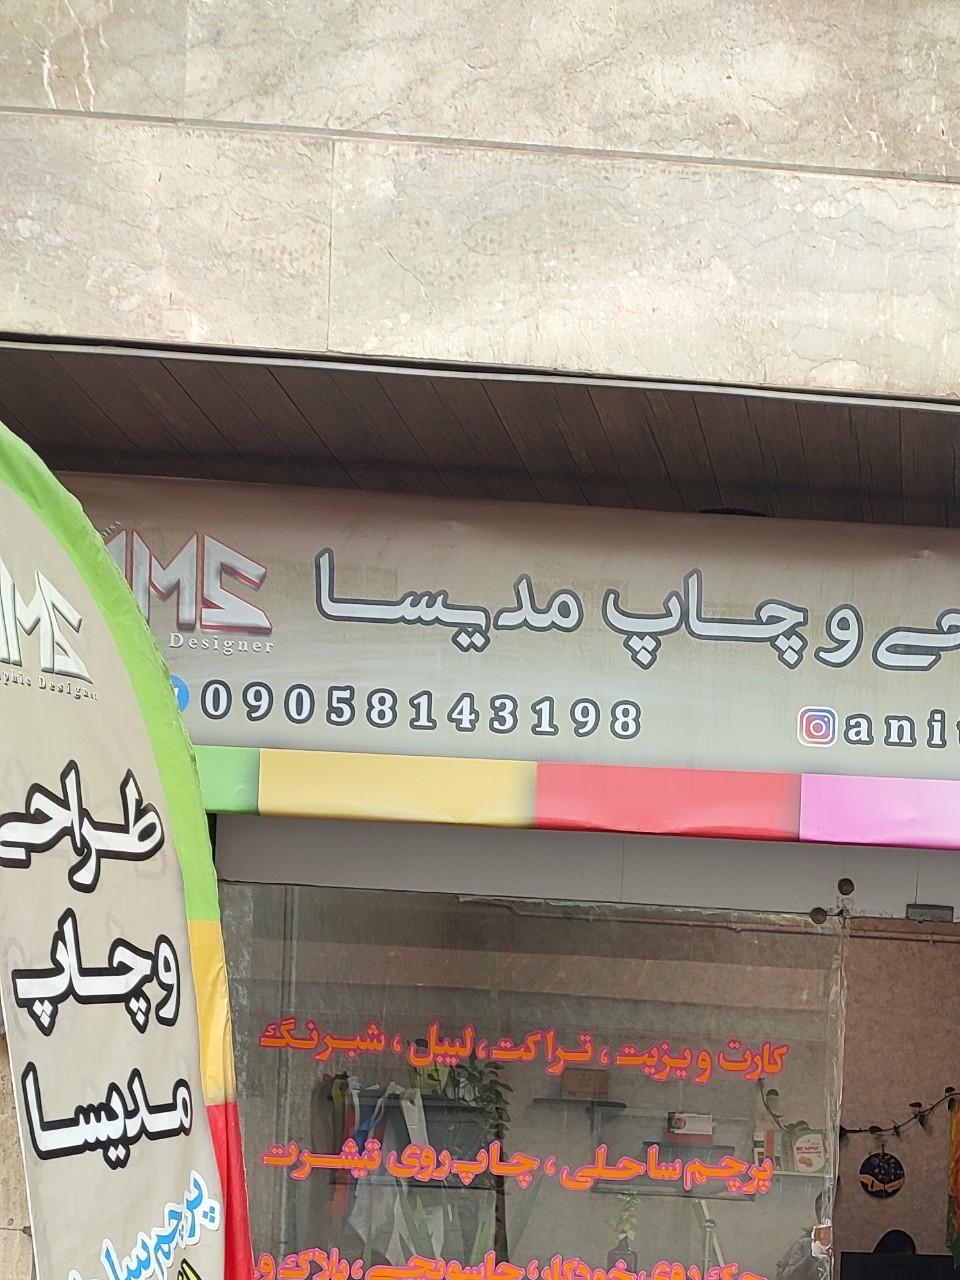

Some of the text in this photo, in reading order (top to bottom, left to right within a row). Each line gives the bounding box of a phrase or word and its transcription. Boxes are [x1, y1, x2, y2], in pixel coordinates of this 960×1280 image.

[103, 529, 273, 634] MS
[315, 546, 584, 653] مدیسا
[168, 632, 275, 655] Designer
[601, 569, 808, 672] چاپ
[201, 679, 641, 740] 09058143198
[0, 760, 165, 893] طراحی
[259, 1016, 386, 1063] شبرنگ
[717, 1038, 788, 1081] کارت
[22, 1062, 193, 1171] مدیسا
[262, 1137, 382, 1180] تیشرت
[386, 1143, 450, 1182] روی
[450, 1139, 540, 1189] چاپ
[683, 1154, 773, 1195] پرچم
